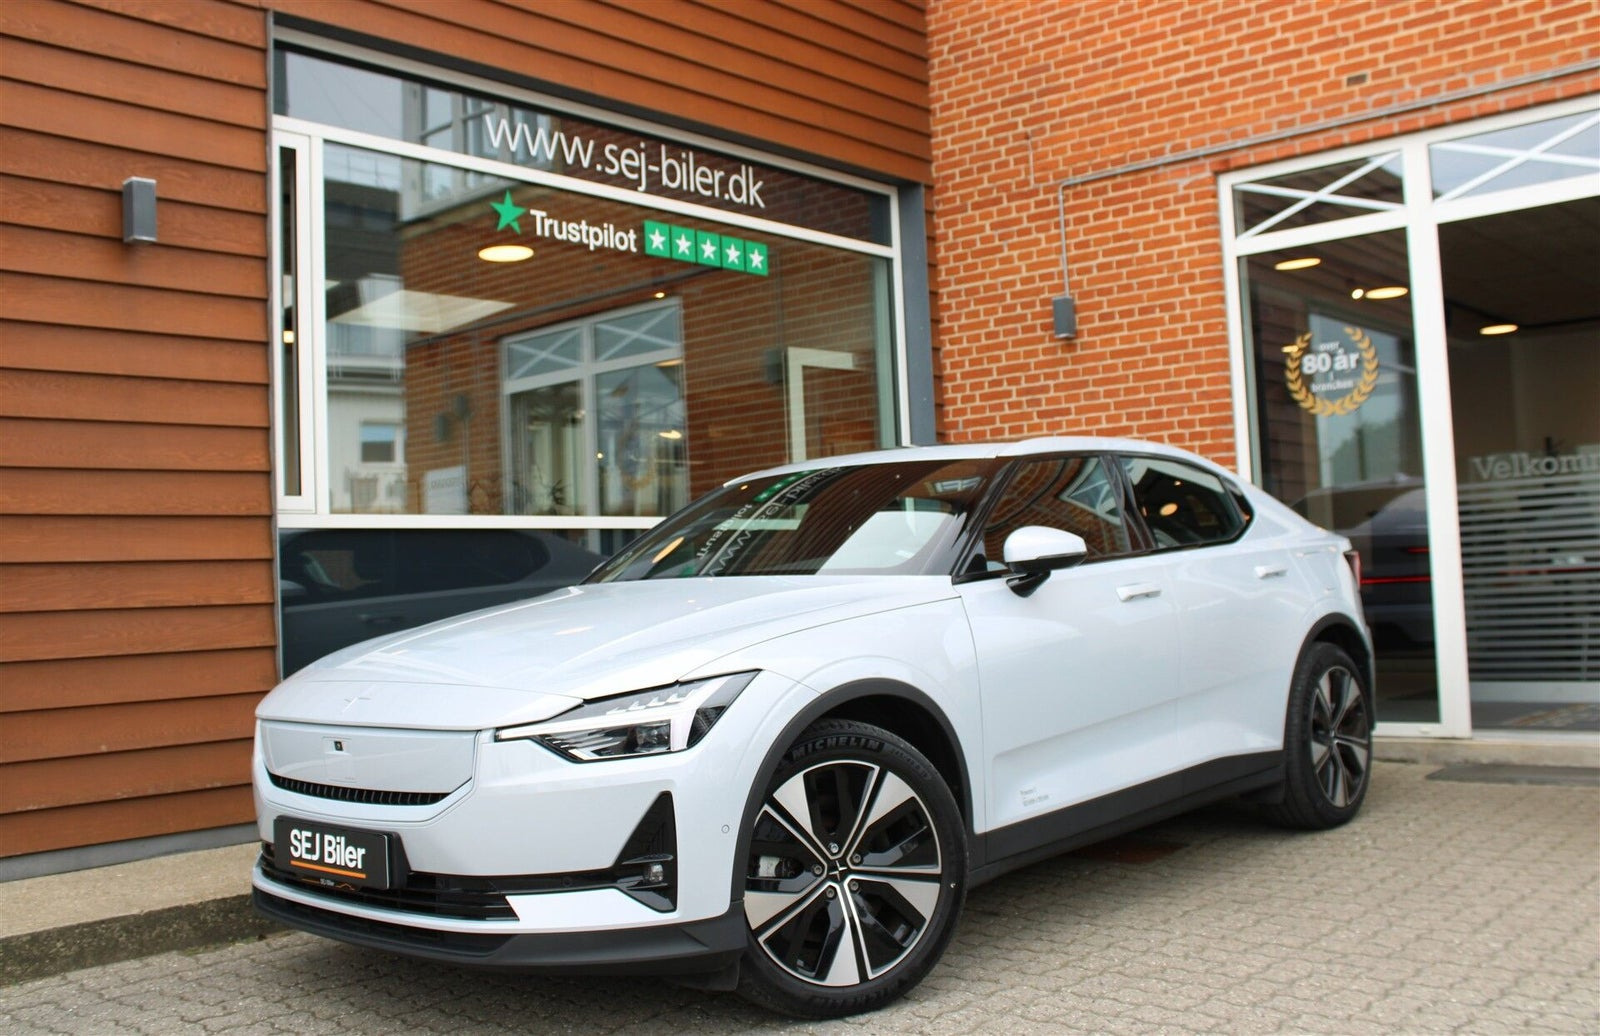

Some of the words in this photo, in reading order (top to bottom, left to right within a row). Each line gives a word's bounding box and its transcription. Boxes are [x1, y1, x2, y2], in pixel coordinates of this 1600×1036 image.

[484, 113, 766, 209] www.sej-biler.dk
[529, 208, 637, 252] Trustpilot
[1301, 352, 1332, 375] 80
[1334, 347, 1360, 371] år
[792, 735, 882, 761] MICHELIN
[289, 828, 321, 861] SEJ
[323, 833, 367, 870] Biler
